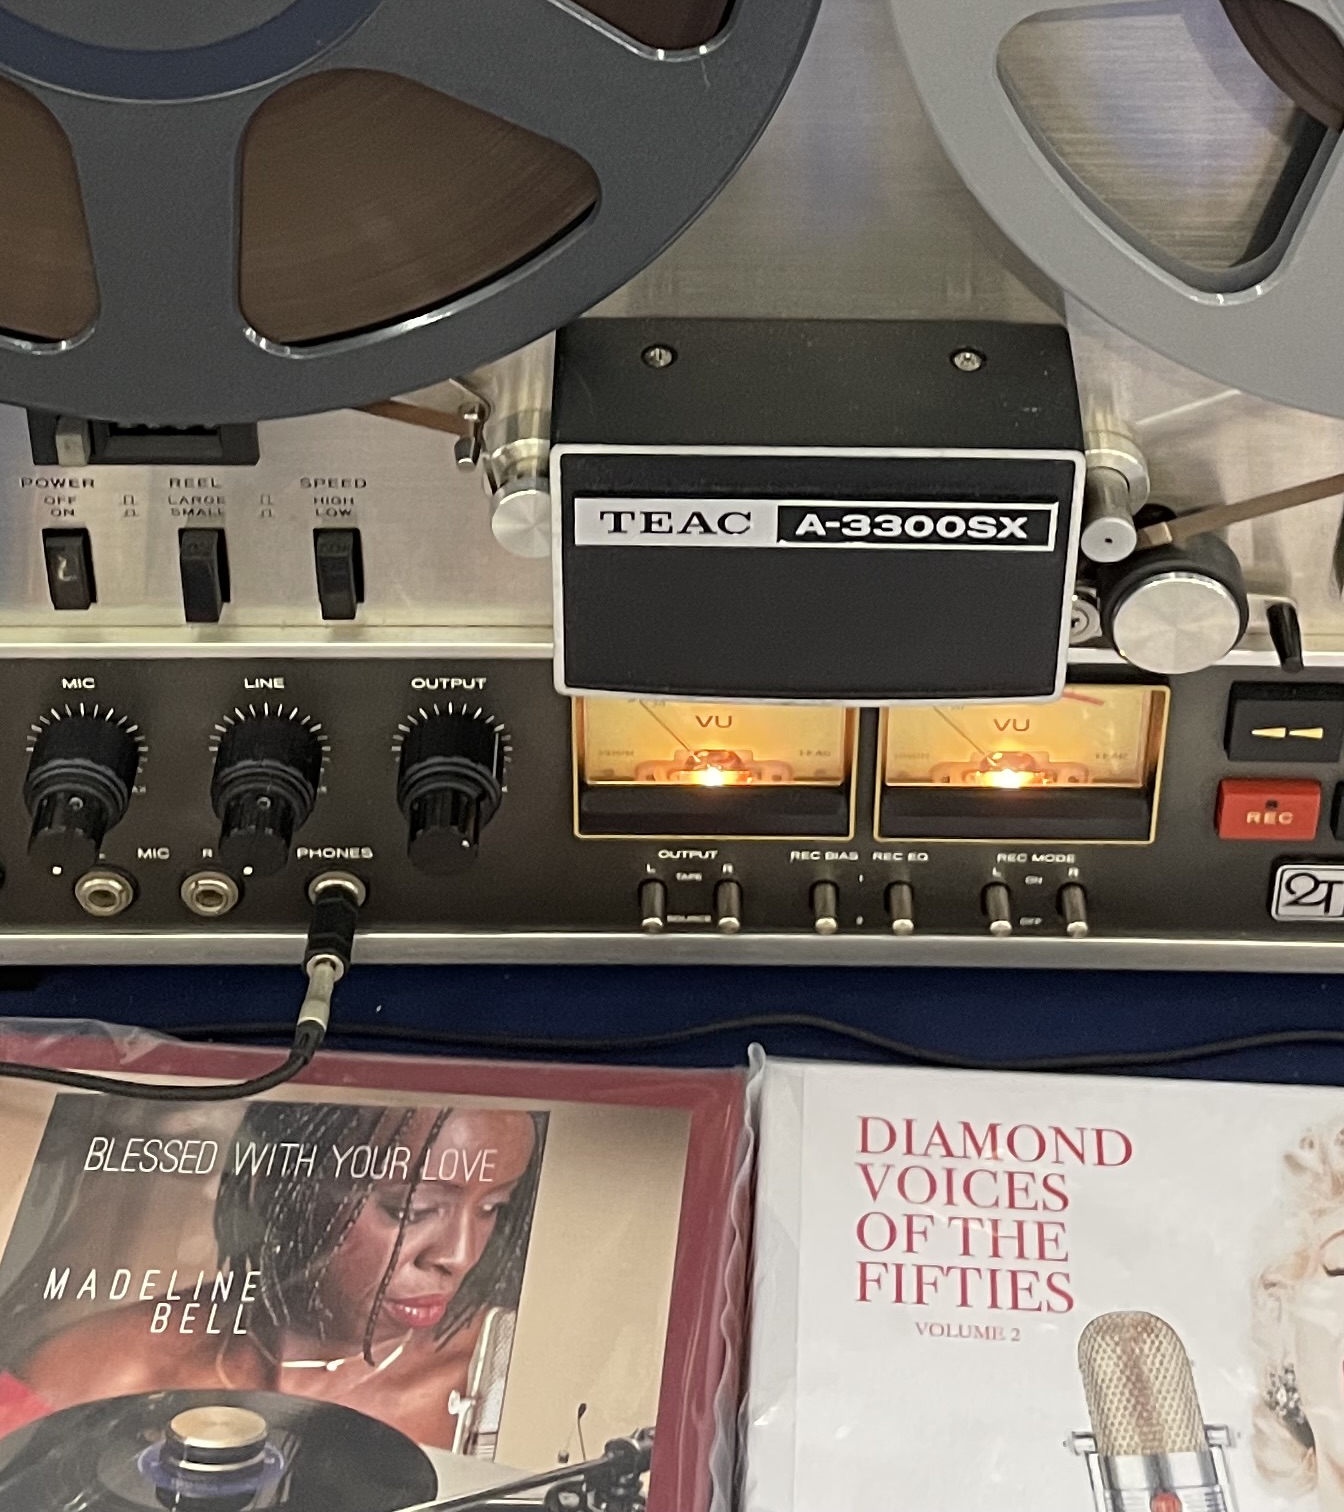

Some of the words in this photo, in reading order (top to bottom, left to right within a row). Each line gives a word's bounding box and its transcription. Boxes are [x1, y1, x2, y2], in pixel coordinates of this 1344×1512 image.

[20, 477, 95, 489] POWER
[169, 477, 222, 489] REEL
[299, 477, 367, 489] SPEED
[167, 495, 226, 506] LARGE
[313, 495, 355, 506] HIGH
[50, 508, 75, 517] ON
[170, 507, 225, 517] SMALL
[315, 507, 352, 518] LOW
[599, 510, 752, 535] TEAC
[795, 512, 1028, 539] A-3300SX
[62, 677, 96, 690] MIC
[244, 677, 285, 690] LINE
[411, 677, 488, 690] OUTPUT
[695, 715, 733, 729] VU
[993, 718, 1031, 732] VU
[1246, 811, 1294, 826] REC
[137, 847, 170, 860] MIC
[296, 846, 374, 859] PHONES
[657, 849, 719, 860] OUTPUT
[790, 850, 820, 861] REC
[824, 850, 859, 861] BIAS
[872, 852, 904, 861] REC
[907, 852, 929, 862] EQ
[996, 852, 1027, 863] REC
[1031, 853, 1076, 863] MODE
[856, 1115, 1134, 1168] DIAMOND
[84, 1136, 219, 1175] BLESSED
[232, 1141, 317, 1178] WITH
[331, 1144, 413, 1180] YOUR
[421, 1147, 499, 1183] LOVE
[856, 1162, 1071, 1213] VOICES
[855, 1211, 936, 1254] OF
[948, 1216, 1069, 1263] THE
[43, 1267, 262, 1303] MADELINE
[855, 1260, 1075, 1314] FIFTIES
[150, 1301, 253, 1336] BELL
[914, 1320, 1006, 1342] VOLUME
[1010, 1327, 1022, 1343] 2
